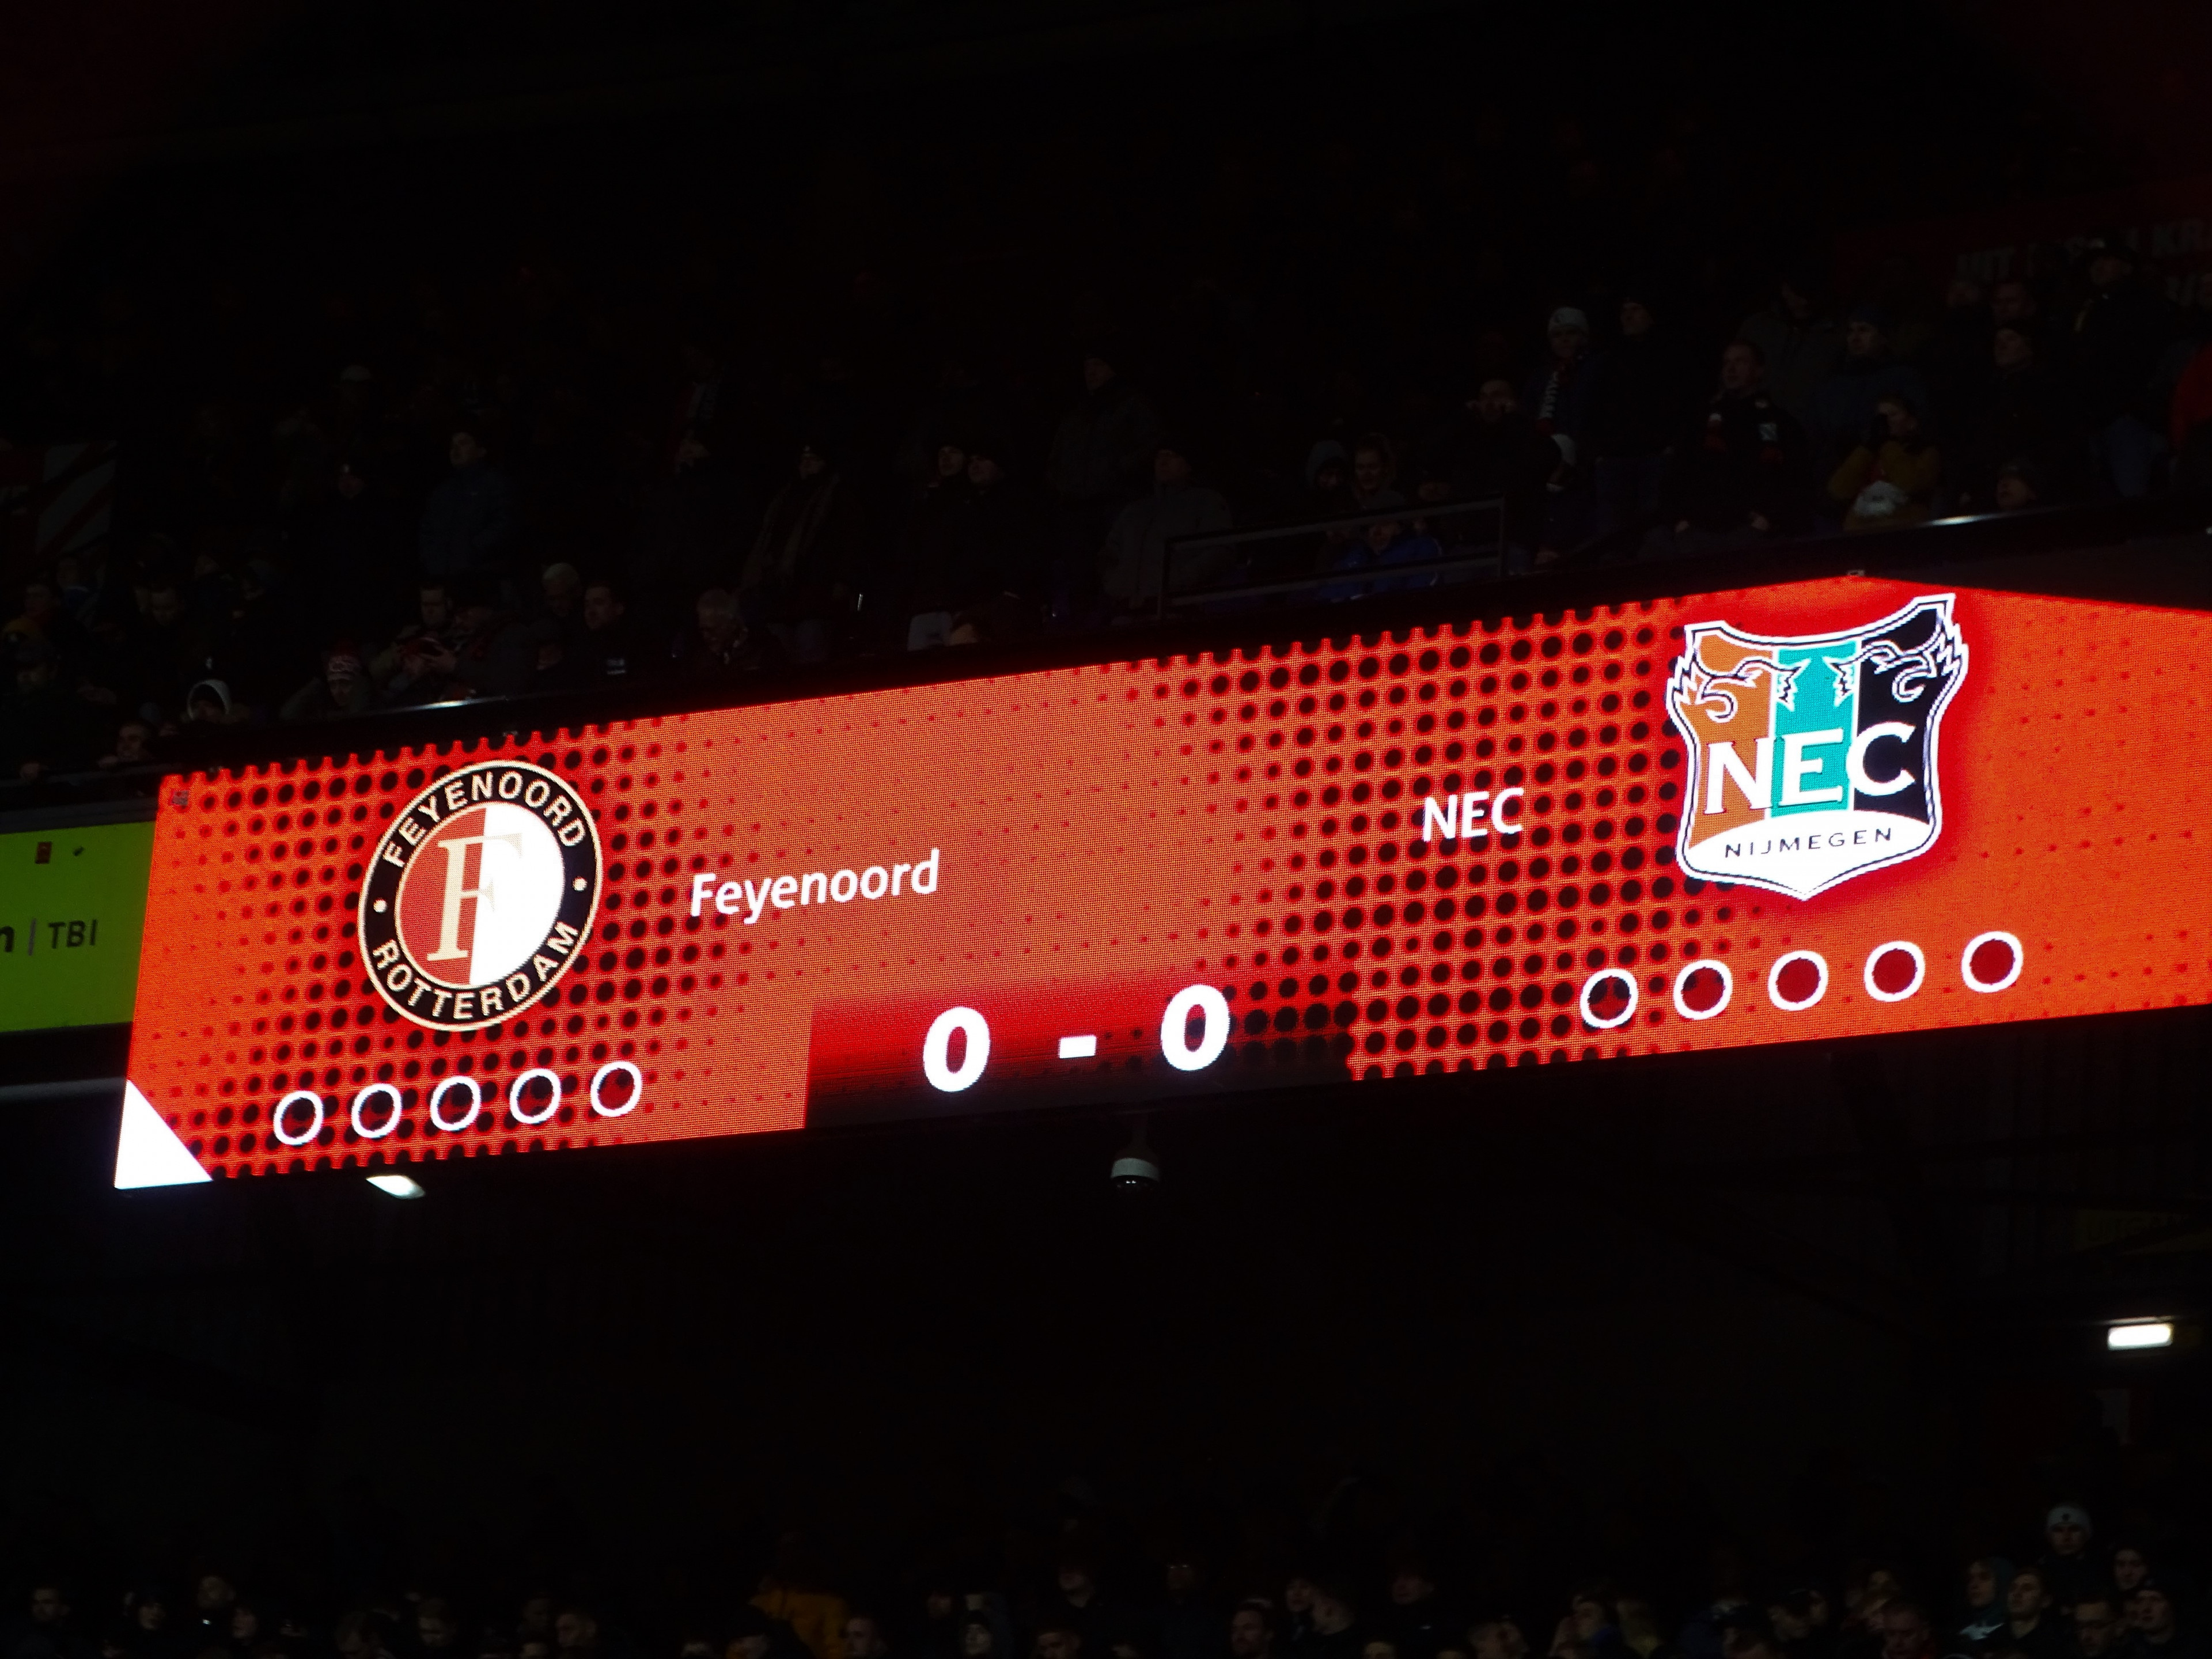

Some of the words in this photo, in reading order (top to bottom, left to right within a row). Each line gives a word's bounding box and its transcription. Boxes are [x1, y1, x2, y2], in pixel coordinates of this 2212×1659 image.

[1704, 721, 1916, 814] NEC
[382, 771, 586, 868] FEYENOORD
[1422, 787, 1524, 842] NEC
[1725, 827, 1892, 858] NIJMEGEN
[426, 832, 523, 961] F
[691, 847, 940, 925] Feyenoord
[48, 919, 98, 949] TBI
[373, 921, 578, 1020] ROTTERDAM
[923, 1005, 991, 1092] 0
[1160, 984, 1230, 1071] 0
